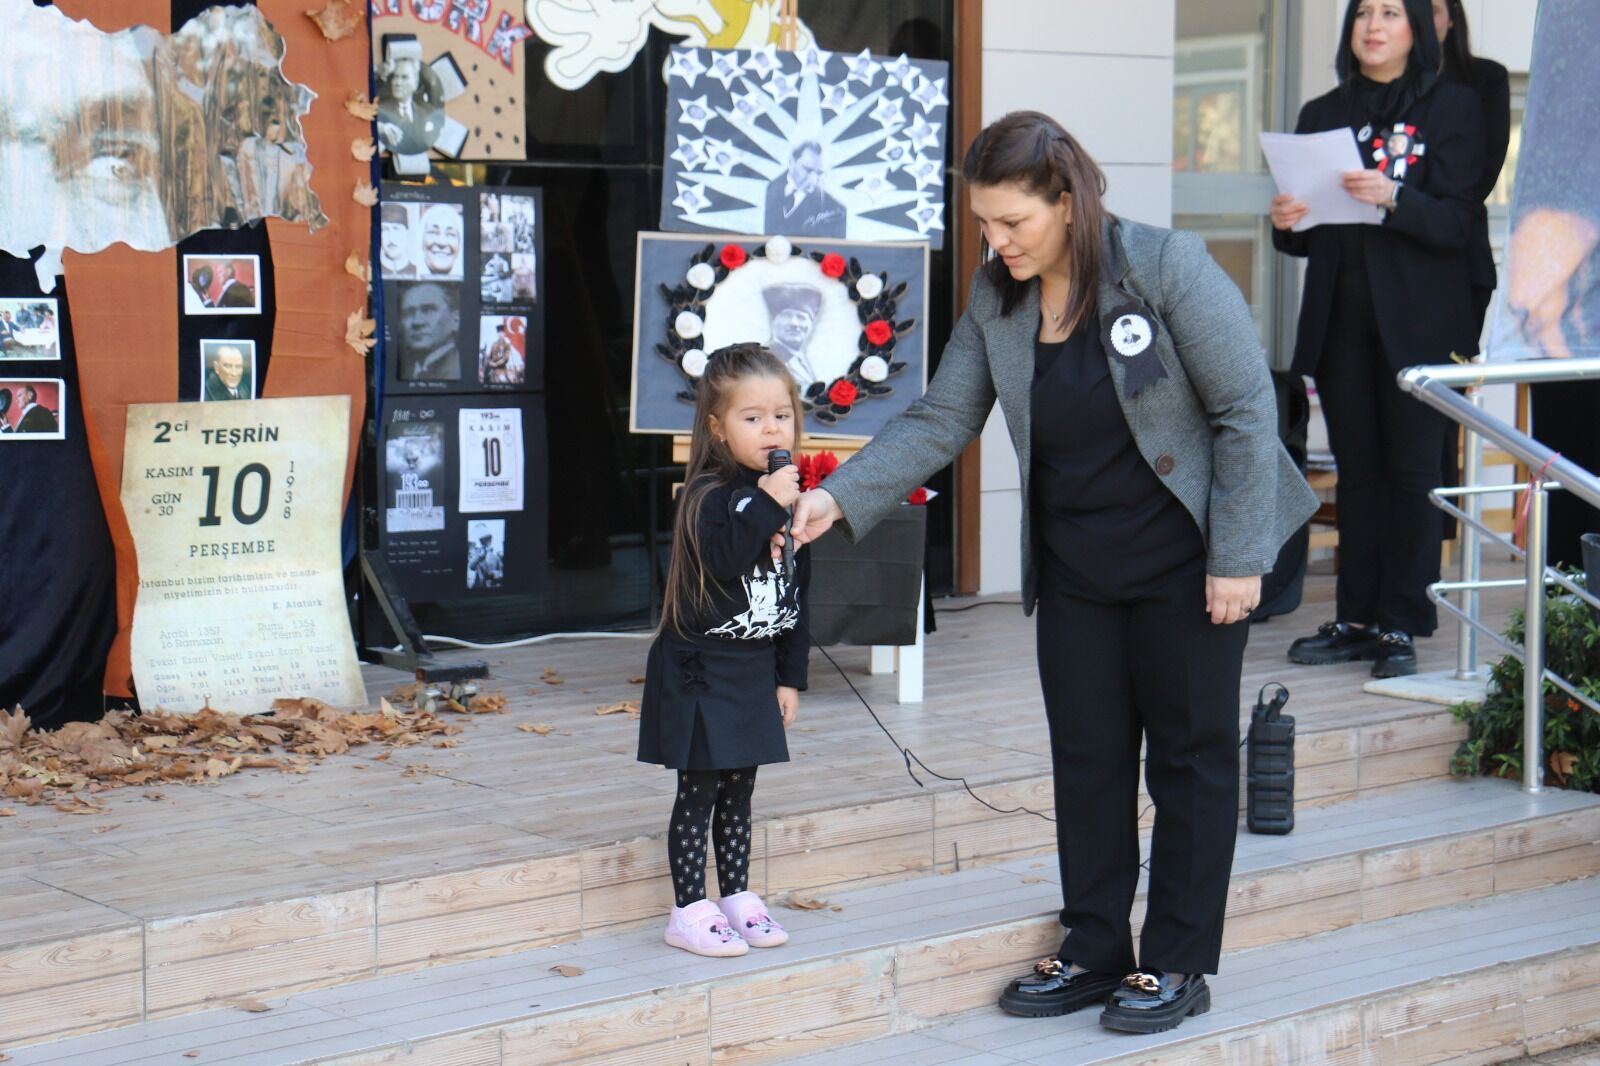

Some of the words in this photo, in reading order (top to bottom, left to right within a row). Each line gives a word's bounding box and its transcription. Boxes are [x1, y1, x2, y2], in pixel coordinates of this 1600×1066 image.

[201, 423, 279, 448] TEŞRİN
[482, 437, 502, 477] 10
[144, 466, 194, 480] KASIM
[151, 491, 182, 505] GÜN
[198, 462, 271, 527] 10
[158, 505, 174, 517] 30
[189, 540, 276, 560] PERŞEMBE
[187, 576, 215, 585] bizim
[163, 589, 222, 600] niyetimizin
[285, 597, 323, 609] Atatürk
